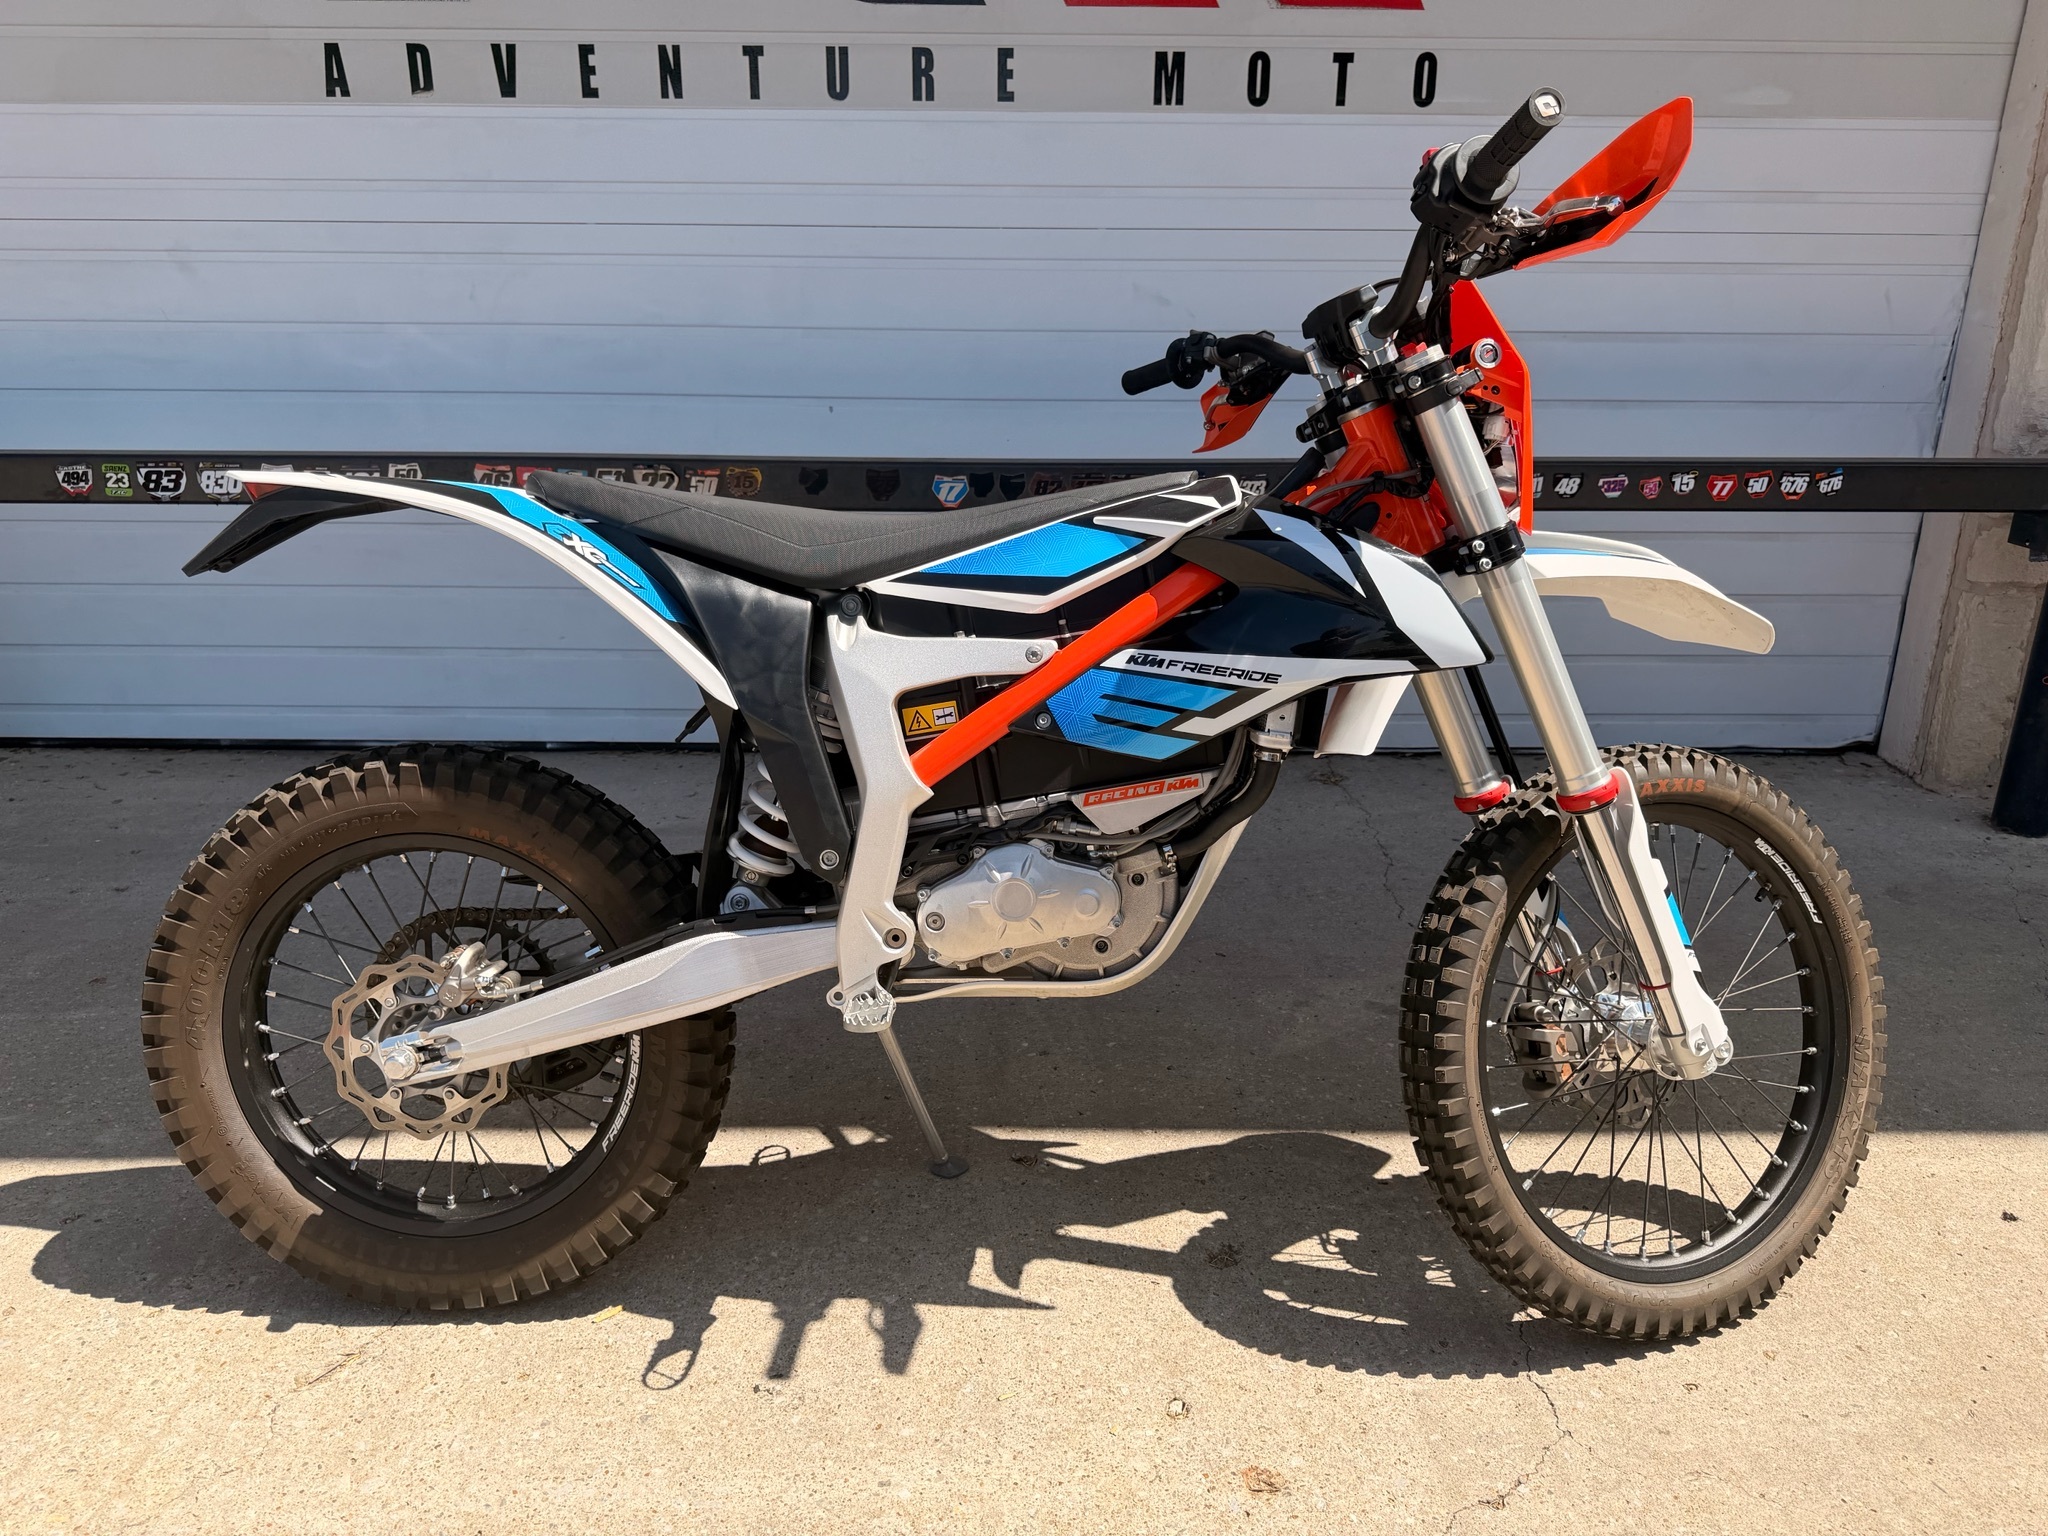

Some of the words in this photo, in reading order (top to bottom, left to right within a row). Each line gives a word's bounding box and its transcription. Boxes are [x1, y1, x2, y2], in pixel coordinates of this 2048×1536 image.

[324, 42, 1015, 103] ADVENTURE
[1153, 51, 1438, 108] MOTO
[62, 471, 90, 486] 494
[105, 473, 130, 488] 23
[142, 470, 184, 492] 83
[200, 470, 243, 494] 830
[690, 476, 719, 496] 50
[1554, 477, 1581, 495] 48
[1712, 480, 1734, 496] 77
[1747, 476, 1769, 493] 50
[1125, 653, 1166, 669] KTM
[1166, 660, 1282, 684] FREERIDE
[1087, 783, 1162, 804] RACING
[1166, 777, 1199, 792] KTM
[1640, 777, 1706, 798] AXXIS
[1770, 852, 1823, 925] FREERIDE
[601, 1060, 641, 1153] FREERIDE
